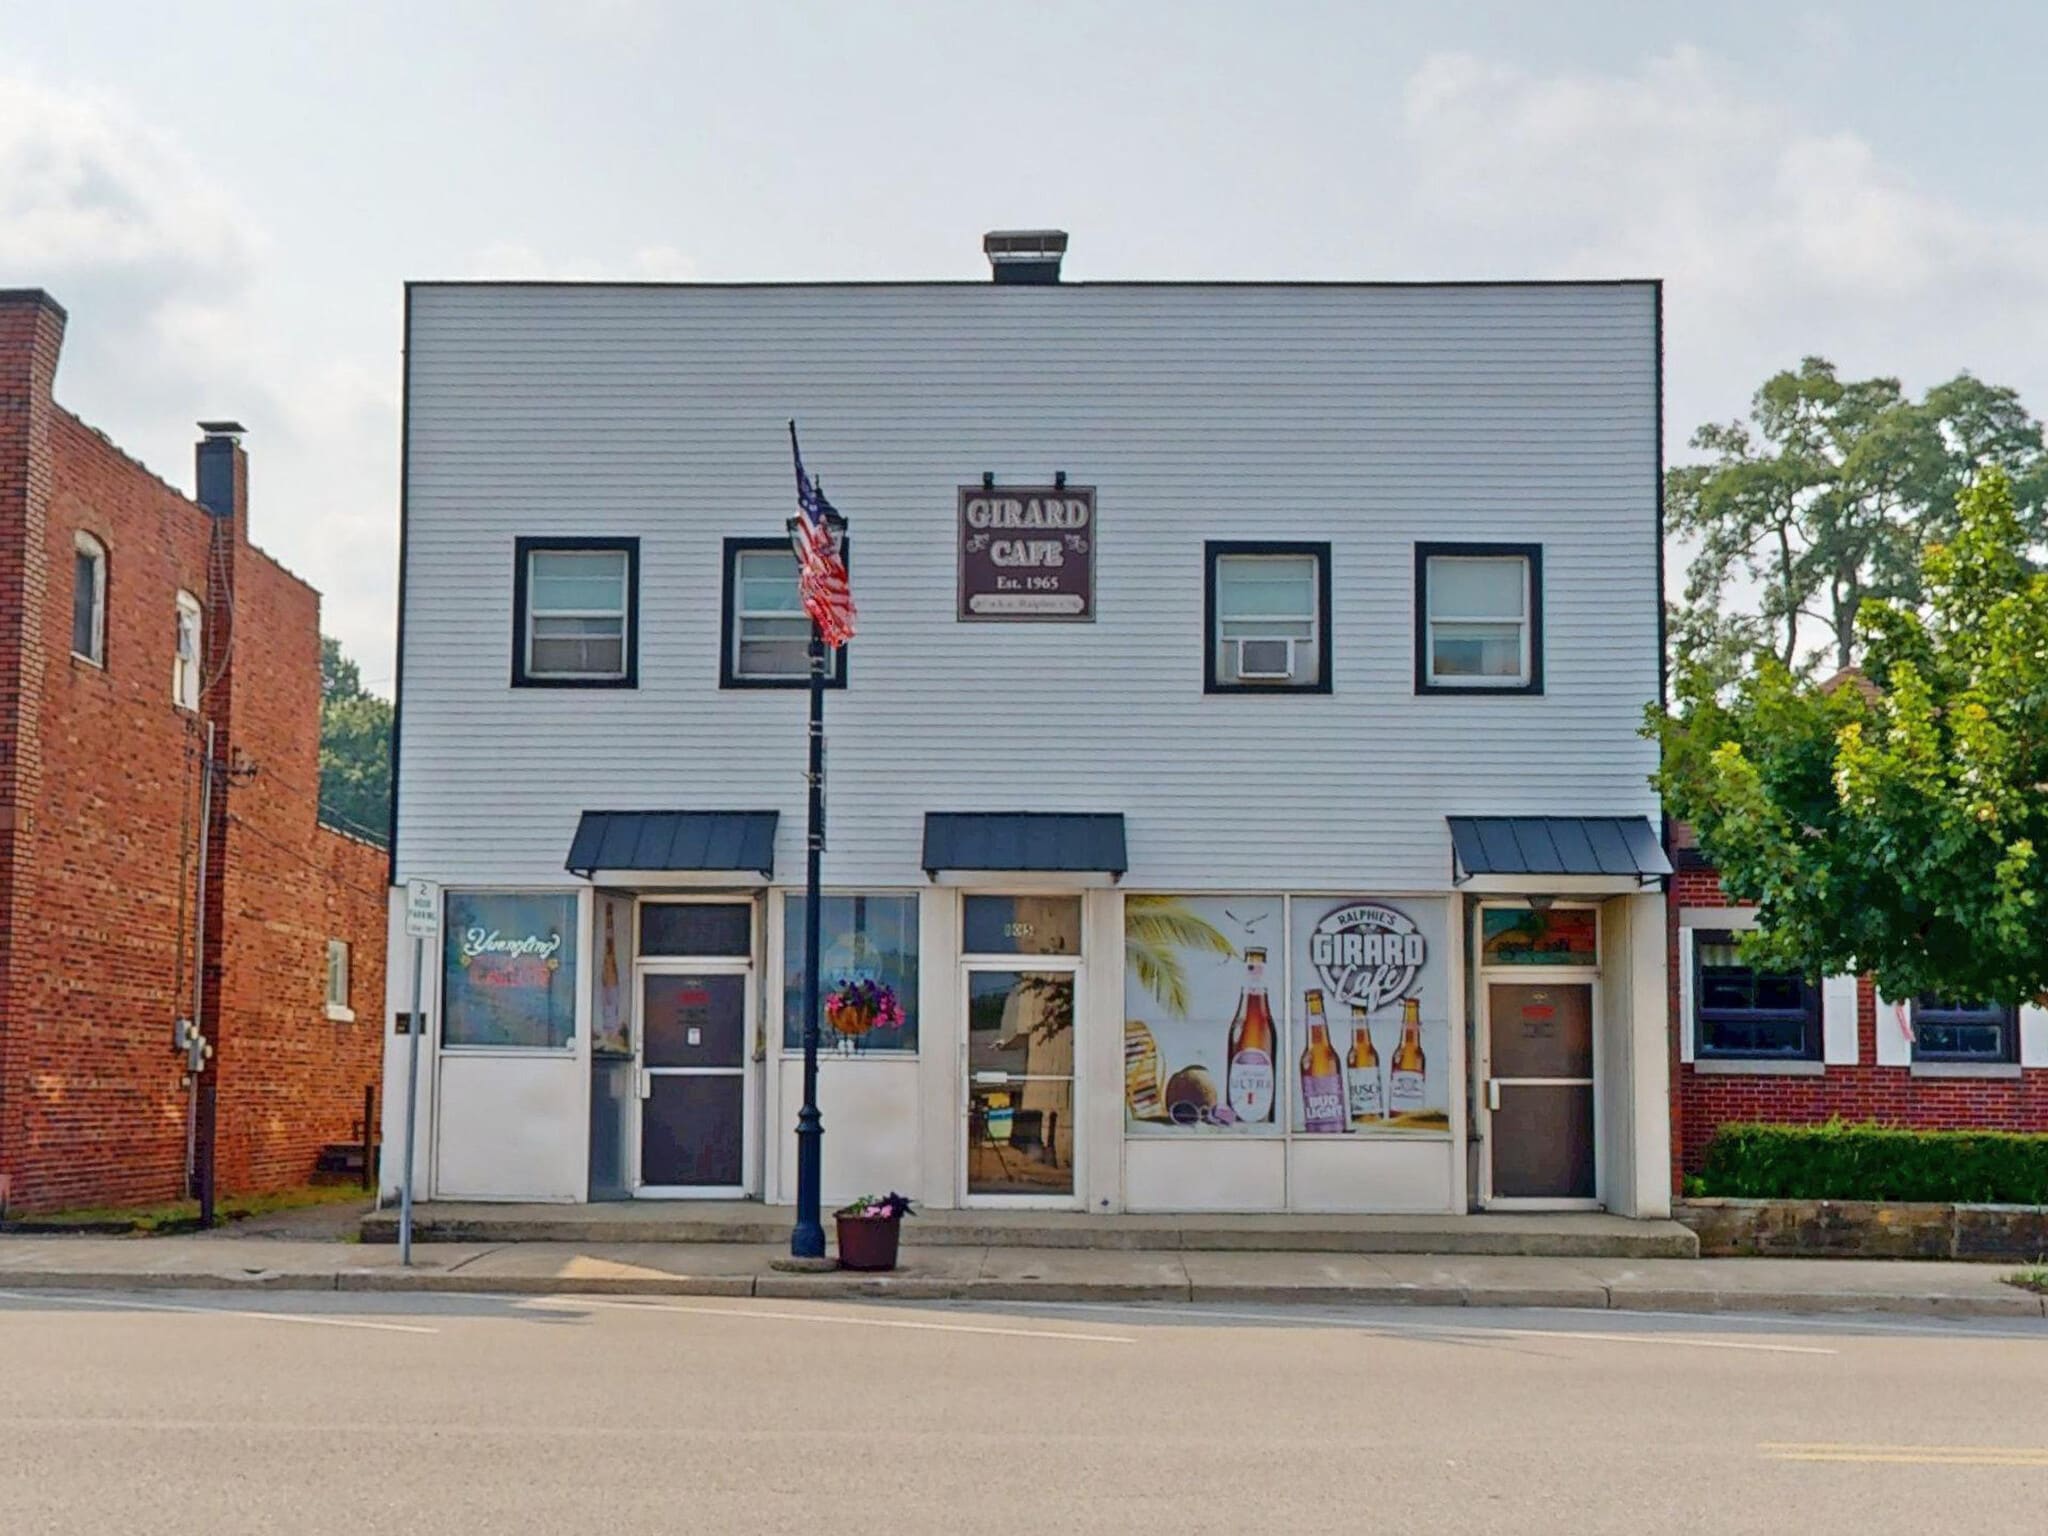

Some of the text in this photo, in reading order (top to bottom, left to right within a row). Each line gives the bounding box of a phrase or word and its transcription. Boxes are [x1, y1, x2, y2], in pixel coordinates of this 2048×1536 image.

[967, 499, 1089, 528] GIRARD
[990, 540, 1064, 567] CAFE
[997, 576, 1059, 590] Est. 1965
[420, 883, 428, 896] 2
[1337, 909, 1397, 926] RALPHIE'S
[463, 927, 561, 959] Yuengling
[1312, 933, 1424, 966] GIRARD
